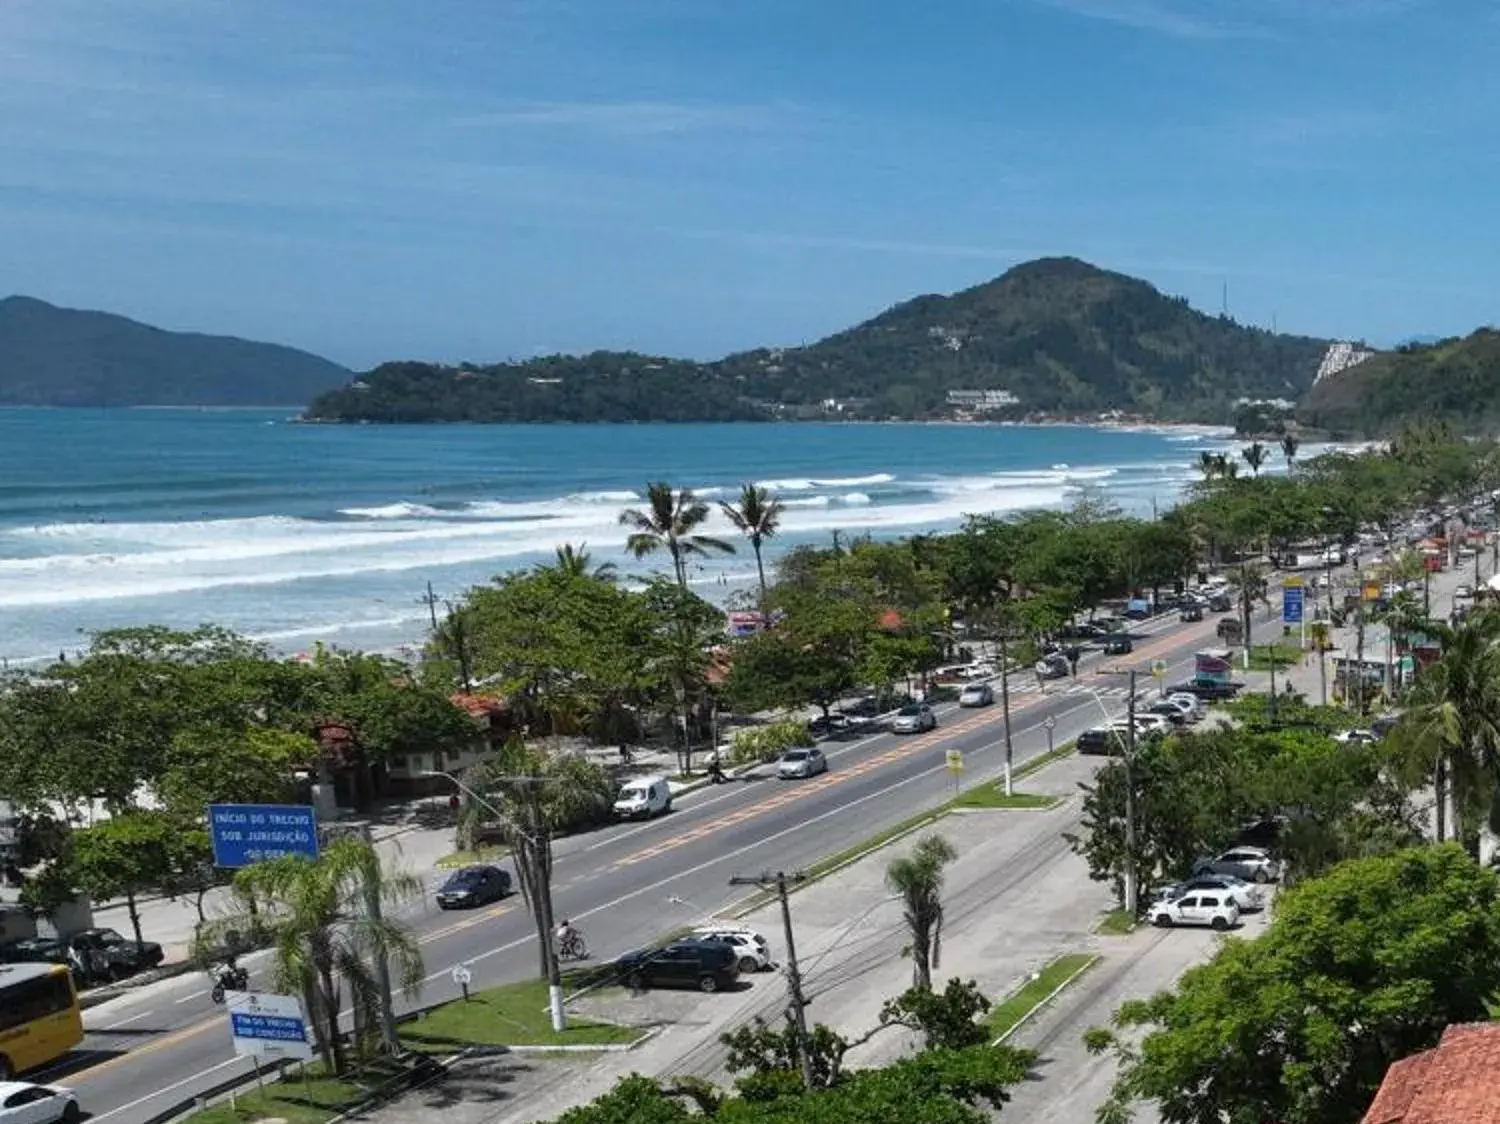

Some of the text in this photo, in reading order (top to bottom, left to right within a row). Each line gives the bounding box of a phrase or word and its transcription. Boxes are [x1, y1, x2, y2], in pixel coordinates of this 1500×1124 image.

[249, 814, 265, 824] DO
[268, 814, 309, 825] TRECHO
[221, 829, 309, 843] SOB JURISDIÇÃO
